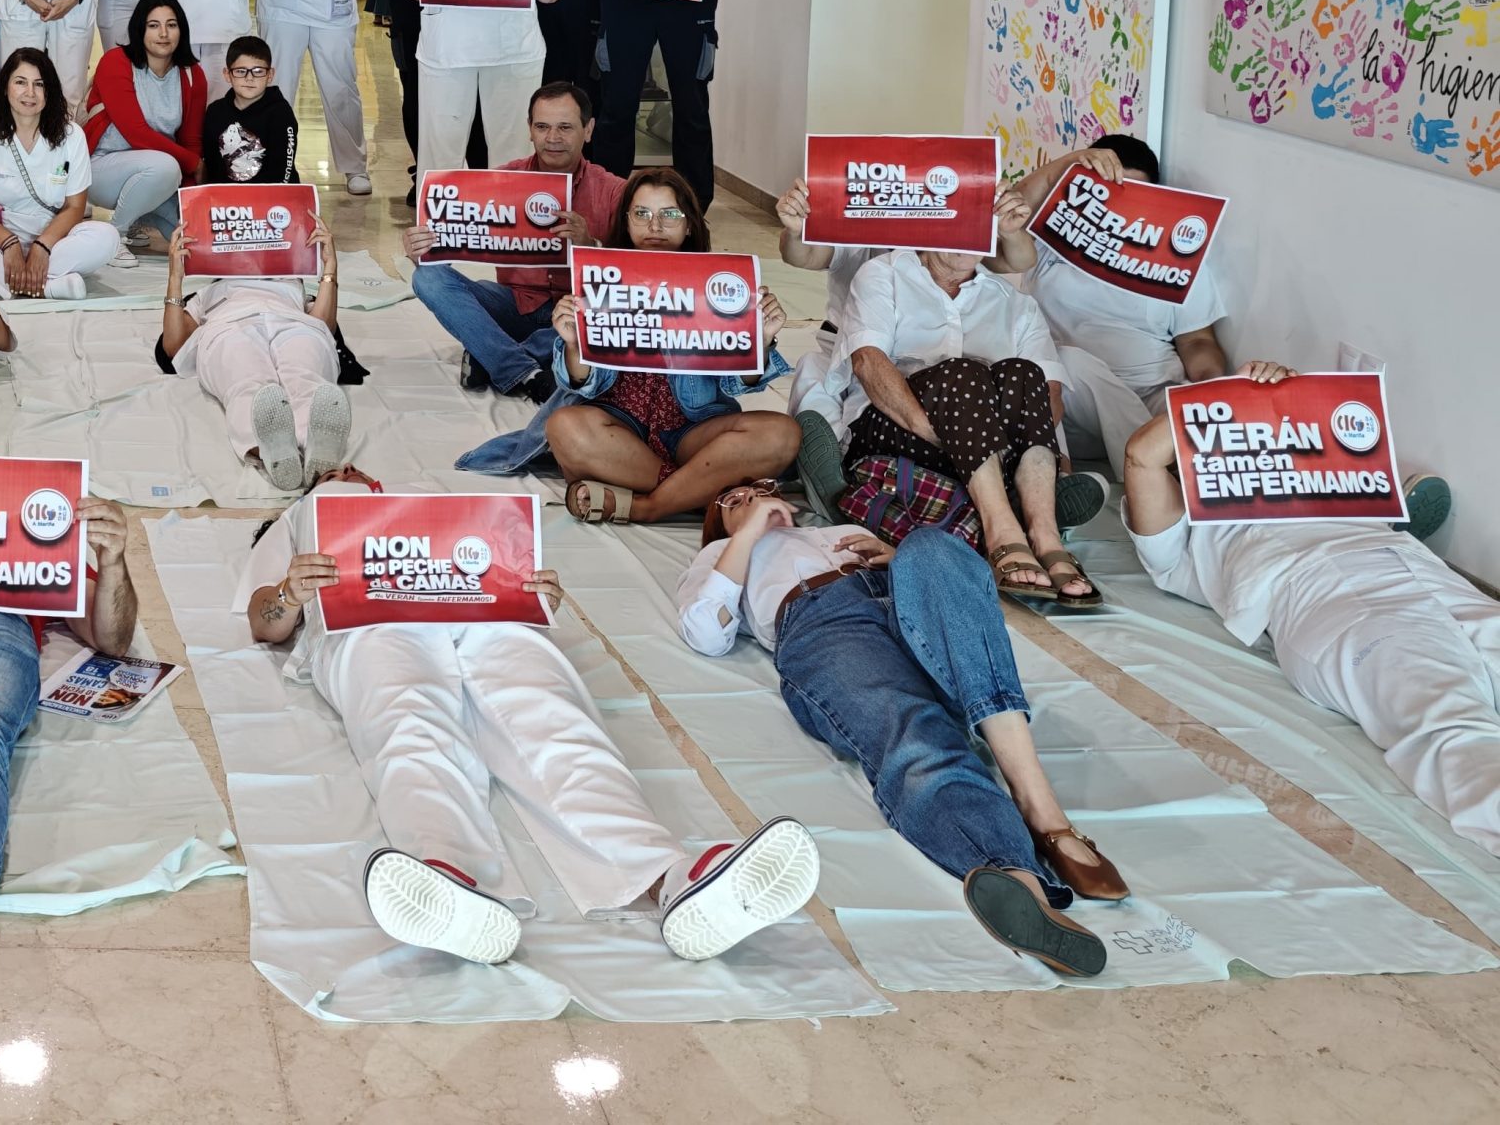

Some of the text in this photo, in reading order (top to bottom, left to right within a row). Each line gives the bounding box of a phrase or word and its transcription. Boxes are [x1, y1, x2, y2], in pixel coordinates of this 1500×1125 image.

[1361, 28, 1380, 83] la
[848, 162, 906, 181] NON
[427, 184, 458, 199] no
[848, 182, 924, 195] ao PECHE
[1073, 174, 1109, 201] no
[851, 194, 946, 206] de CAMAS
[211, 207, 253, 220] NON
[426, 200, 516, 224] VERÁN
[1067, 183, 1164, 247] VERÁN
[228, 220, 267, 229] PECHE
[427, 219, 489, 234] tamén
[1056, 200, 1124, 253] tamén
[215, 229, 283, 241] de CAMAS
[1046, 211, 1191, 286] ENFERMAMOS
[582, 265, 622, 283] no
[583, 282, 695, 311] VERÁN
[584, 309, 662, 328] tamén
[587, 326, 751, 350] ENFERMAMOS
[1182, 402, 1233, 423] no
[1185, 416, 1323, 453] VERÁN
[1193, 450, 1294, 473] tamén
[1196, 470, 1391, 498] ENFERMAMOS
[365, 536, 430, 559] NON
[364, 559, 452, 575] ao PECHE
[370, 575, 481, 591] de CAMAS
[58, 685, 85, 694] PECHE
[66, 675, 108, 689] CAMAS
[48, 689, 92, 707] NON
